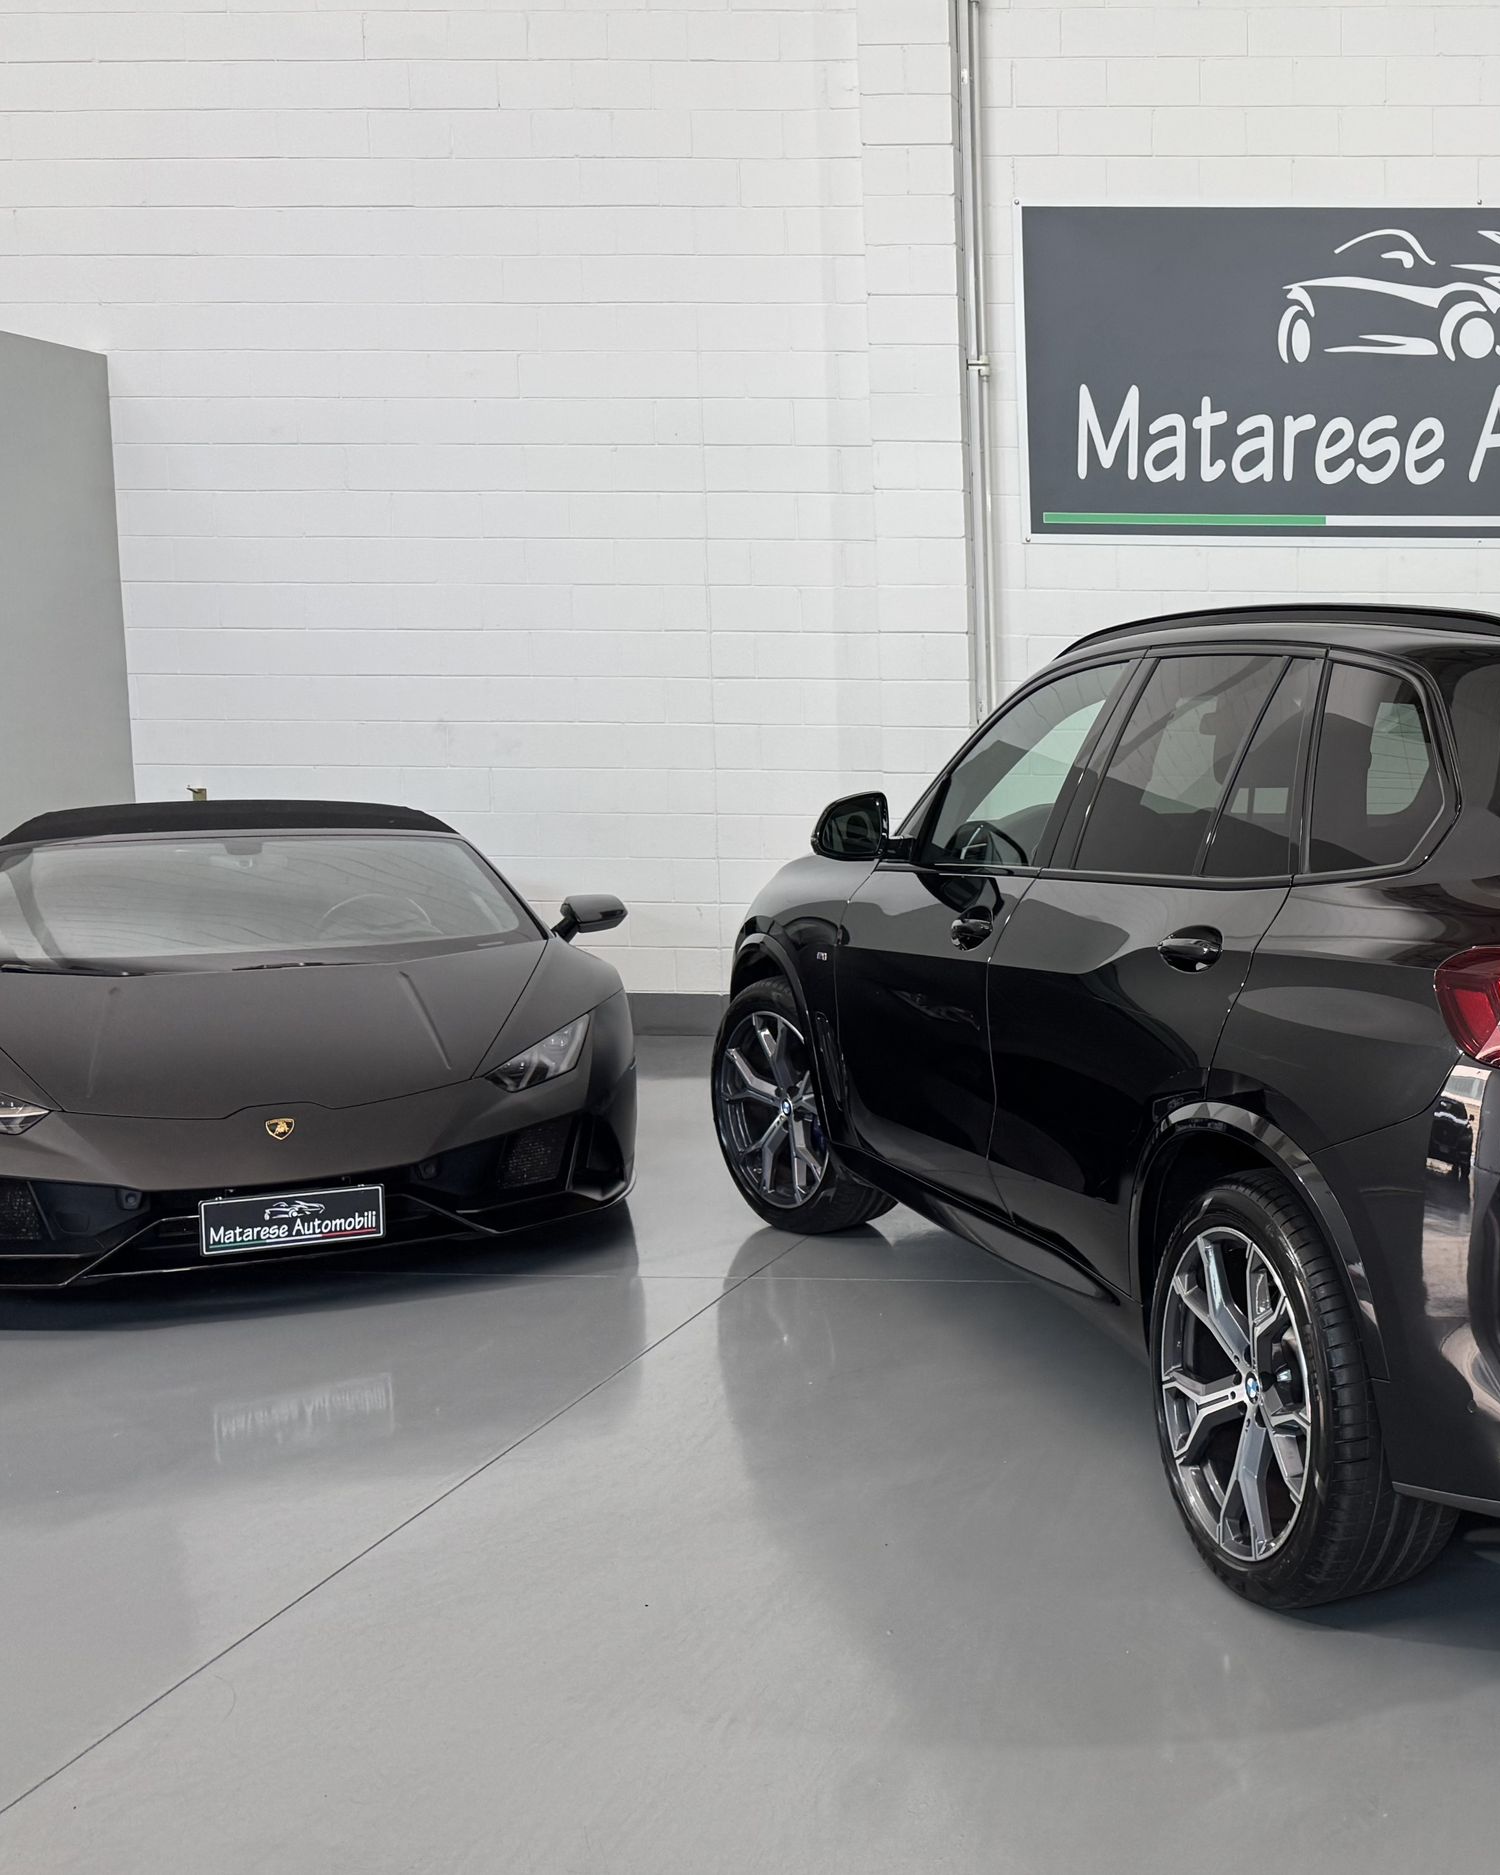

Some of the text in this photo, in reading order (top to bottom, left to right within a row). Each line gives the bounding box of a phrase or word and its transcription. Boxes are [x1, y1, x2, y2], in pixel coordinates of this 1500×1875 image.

[1076, 383, 1446, 485] Matarese
[209, 1210, 377, 1245] Matarese Automobili
